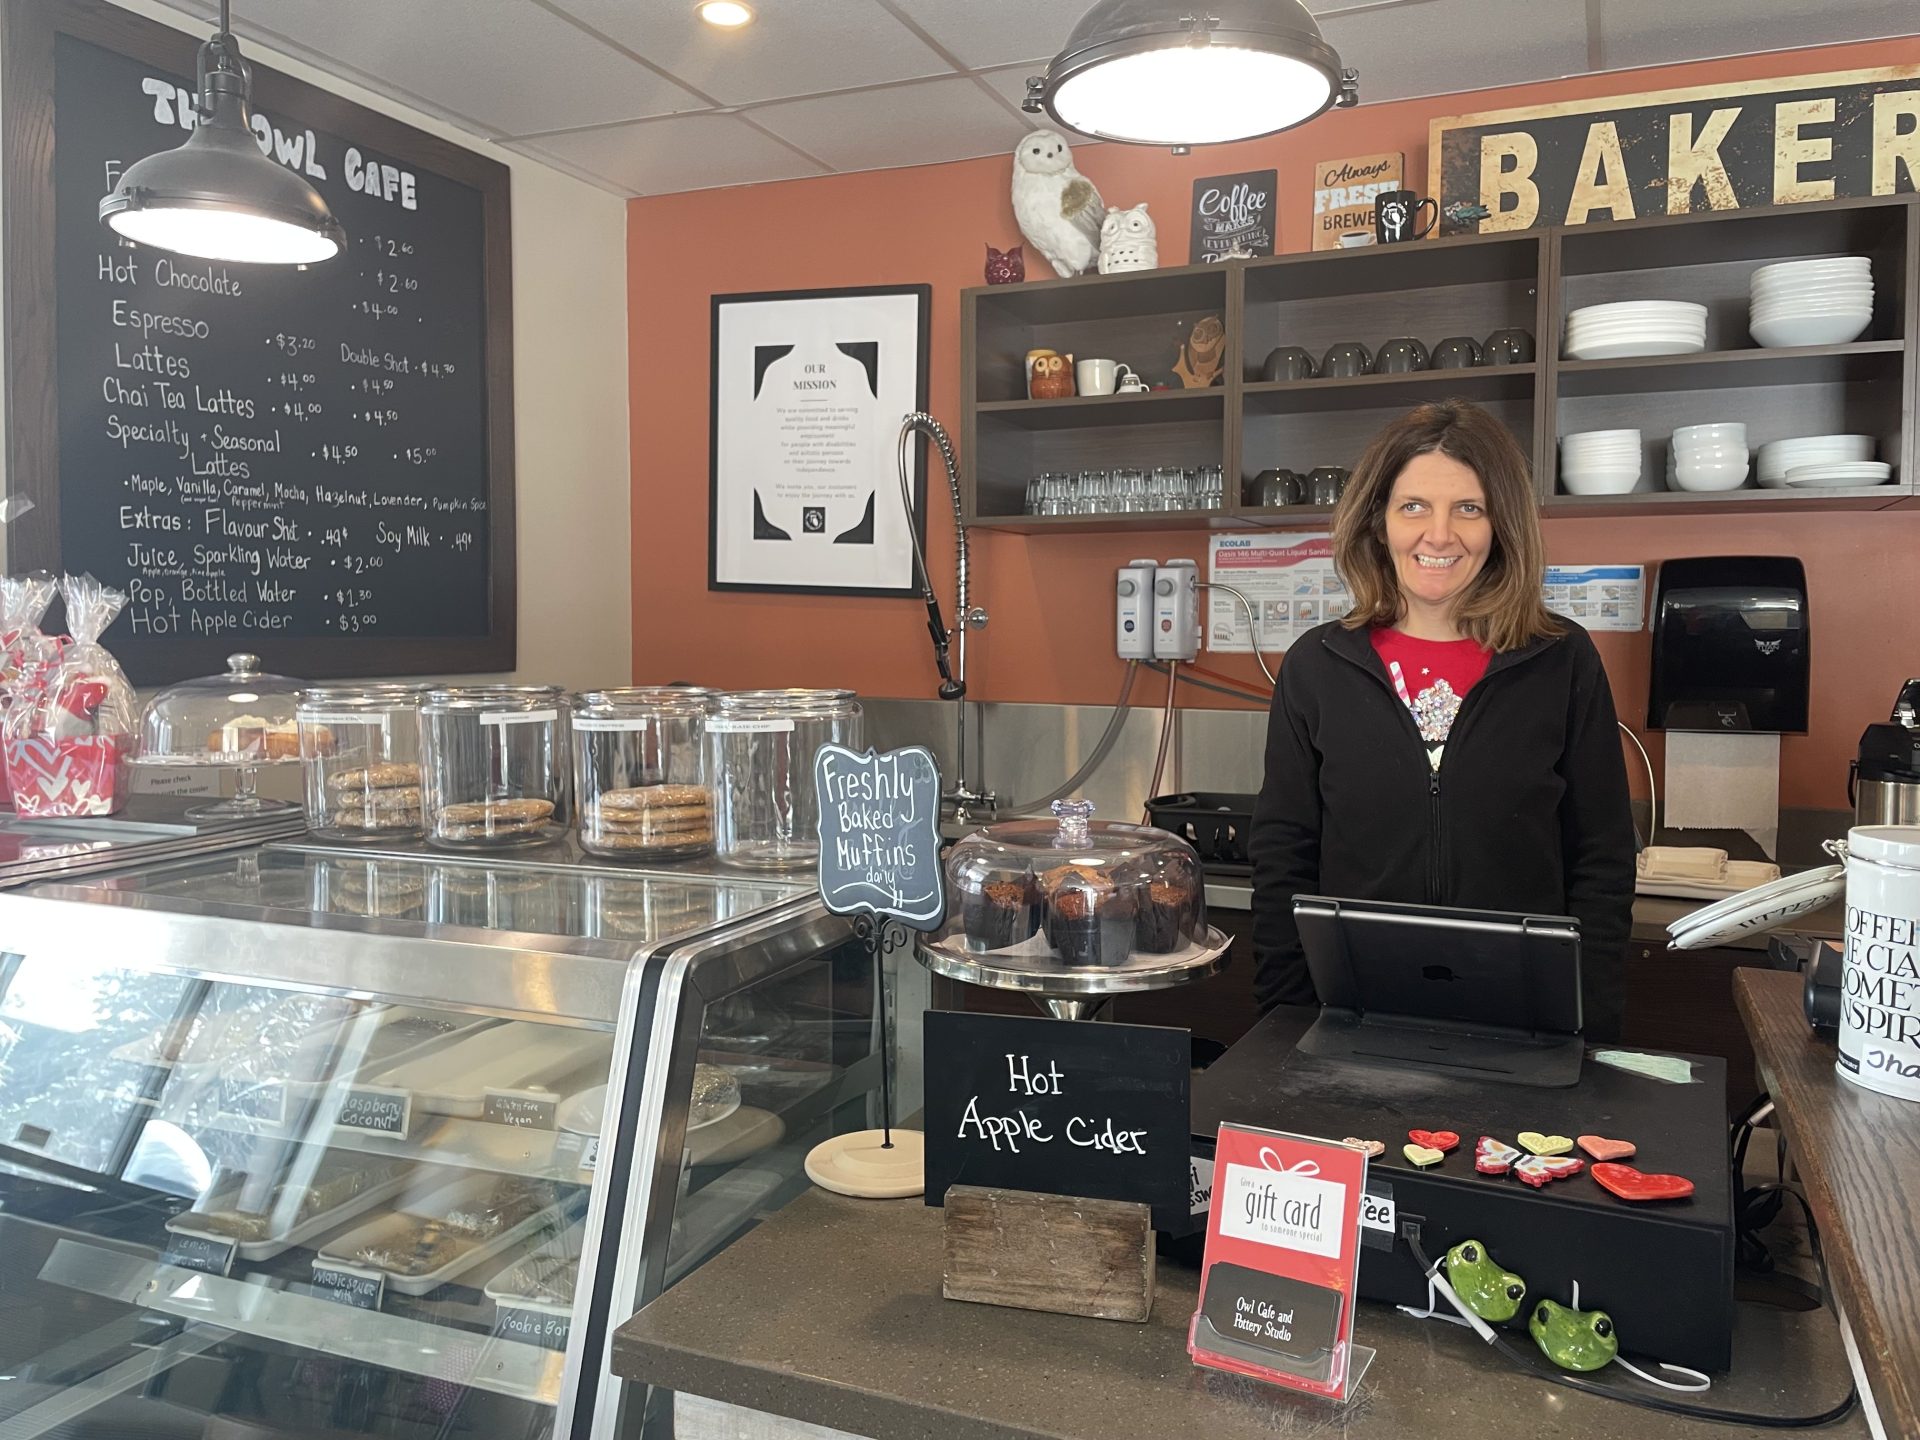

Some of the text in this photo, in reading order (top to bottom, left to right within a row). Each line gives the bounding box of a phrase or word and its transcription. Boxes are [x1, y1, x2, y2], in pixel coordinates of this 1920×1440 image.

[141, 77, 417, 210] TH OWL CAFE
[1324, 159, 1391, 188] Always
[1198, 183, 1267, 223] Coffee
[1214, 215, 1255, 233] MAKES
[1323, 213, 1376, 231] BREWE
[98, 254, 138, 285] Hot
[155, 258, 243, 296] Chocolate
[112, 299, 316, 356] Espresso $3.20
[114, 342, 394, 396] Lattes $4.00 $4.50
[340, 343, 380, 367] Double
[384, 352, 409, 374] Shot
[804, 364, 826, 374] OUR
[793, 380, 837, 390] MISSION
[103, 376, 398, 426] Chai Tea Lattes $4.00 $4.50
[106, 414, 190, 459] Specialty
[210, 424, 281, 453] Seasonal
[322, 444, 358, 464] $4.50
[406, 447, 437, 464] $5.00
[191, 451, 250, 479] Lattes
[131, 474, 173, 496] Maple,
[175, 476, 221, 497] Vanilla,
[223, 478, 270, 502] Caramel,
[274, 482, 309, 505] Mocha,
[315, 485, 373, 509] Hazelnut,
[432, 497, 468, 513] Pumpkin
[470, 498, 487, 511] Spice
[231, 496, 285, 511] Peppermint
[205, 508, 269, 538] Flavour
[271, 515, 300, 542] Shot
[375, 521, 401, 552] Soy
[406, 525, 430, 547] Milk
[1219, 540, 1251, 548] ECOLAB
[127, 543, 384, 576] Juice, Sparkling Water $2.00
[1218, 550, 1237, 558] Oasis
[1250, 549, 1285, 557] Multi-Quat
[1286, 548, 1308, 557] Liquid
[129, 578, 372, 611] Pop, Bottled Water $1.30
[130, 605, 181, 634] Hot
[191, 608, 237, 636] Apple
[242, 610, 293, 629] Cider
[822, 754, 915, 823] Freshly
[838, 801, 894, 833] Baked
[836, 832, 916, 870] Muffins
[866, 866, 896, 890] daily
[1845, 903, 1916, 947] OFFE
[1842, 996, 1920, 1049] NSPIR
[1005, 1054, 1064, 1095] Hot
[341, 1110, 393, 1129] Coconut
[503, 1112, 532, 1128] Vegan
[957, 1095, 1148, 1155] Apple Cider
[1240, 1177, 1250, 1187] Give
[1245, 1184, 1278, 1224] gift
[1283, 1193, 1322, 1230] card
[1261, 1223, 1323, 1242] to someone special
[313, 1270, 346, 1287] Magic
[502, 1315, 541, 1334] Cookie
[1236, 1296, 1294, 1324] Owl Cafe and
[1233, 1312, 1292, 1342] Pottery Studio
